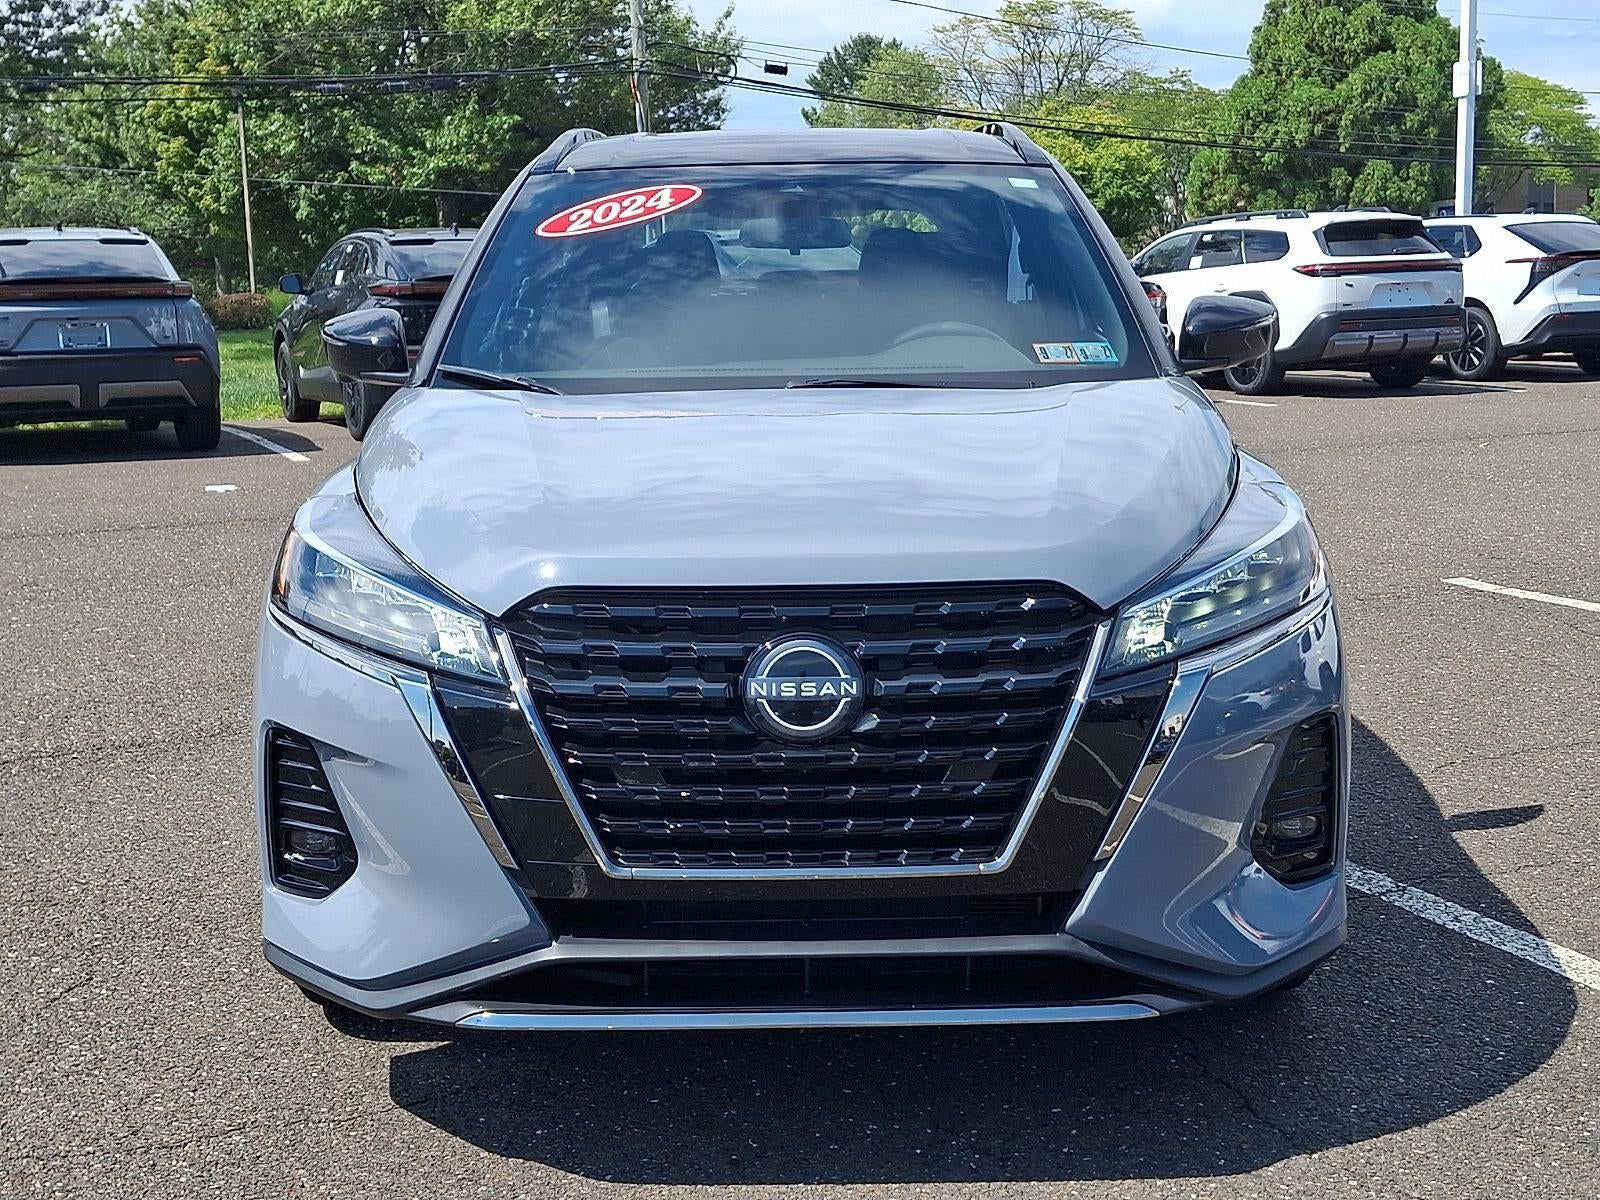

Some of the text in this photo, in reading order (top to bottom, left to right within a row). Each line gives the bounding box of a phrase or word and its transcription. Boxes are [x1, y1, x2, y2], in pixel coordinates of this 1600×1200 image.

[566, 188, 676, 233] 2024
[1039, 346, 1050, 360] 9
[1079, 348, 1090, 360] 9
[750, 681, 857, 697] NISSAN
